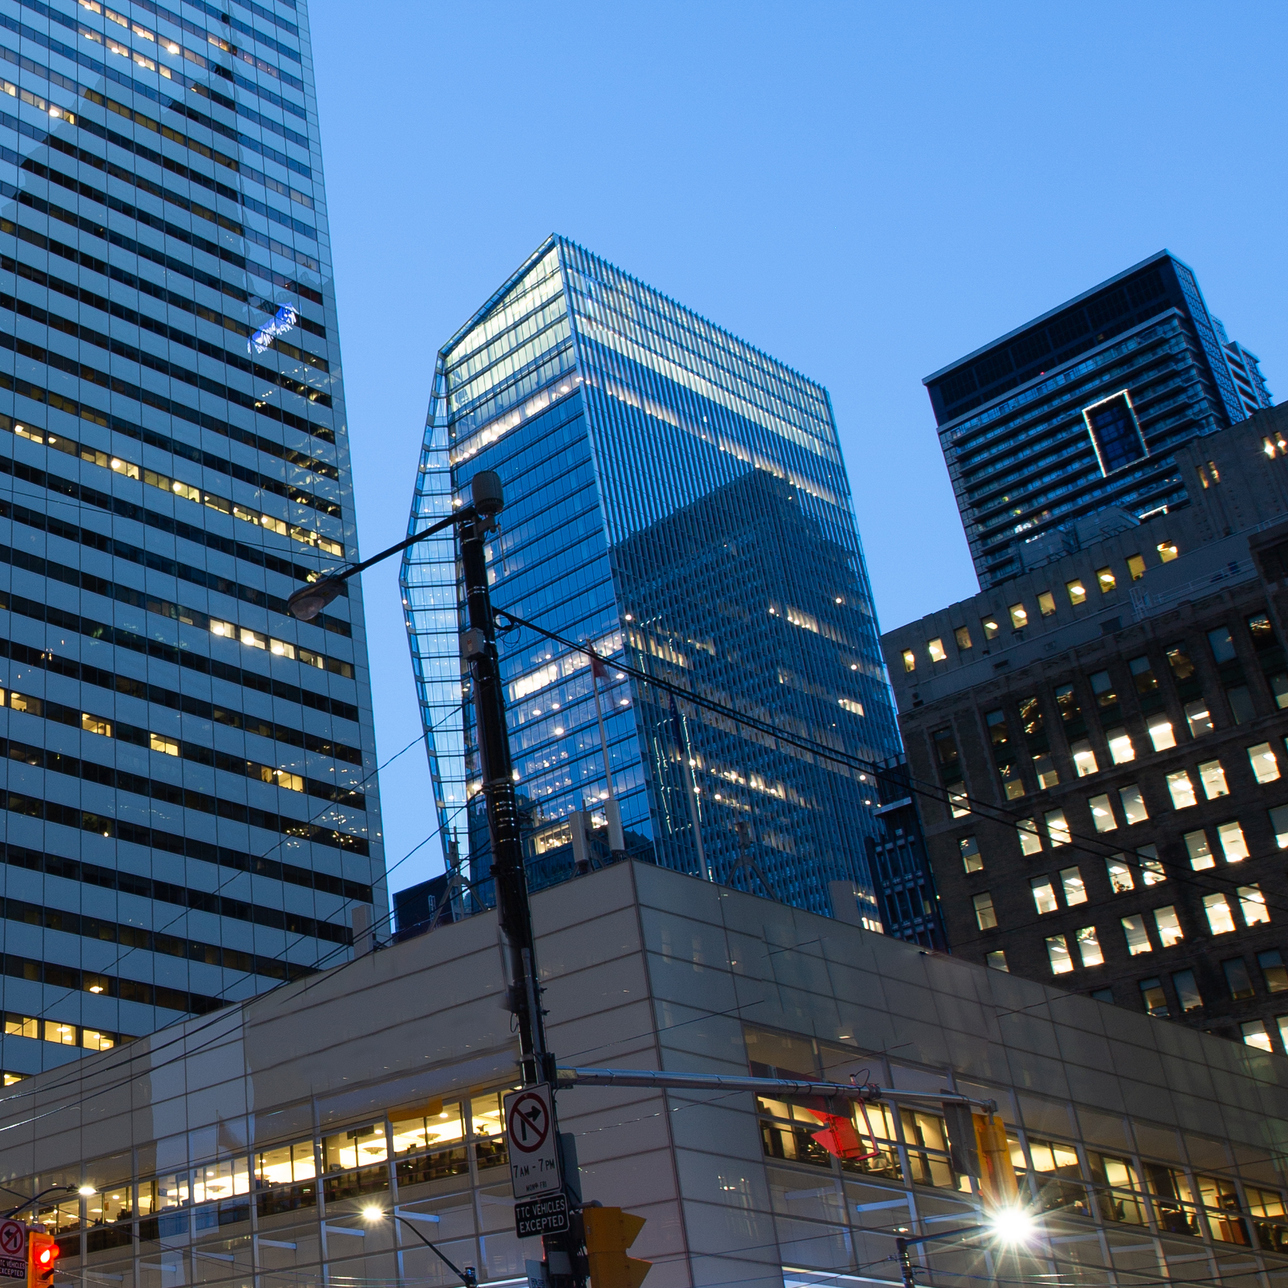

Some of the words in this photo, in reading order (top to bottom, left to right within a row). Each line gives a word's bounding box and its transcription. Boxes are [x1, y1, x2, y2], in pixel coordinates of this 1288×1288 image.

[516, 1206, 530, 1219] TTC
[532, 1199, 565, 1216] VEHICLES
[519, 1215, 564, 1233] EXCEPTED
[6, 1261, 25, 1270] VEHICLES
